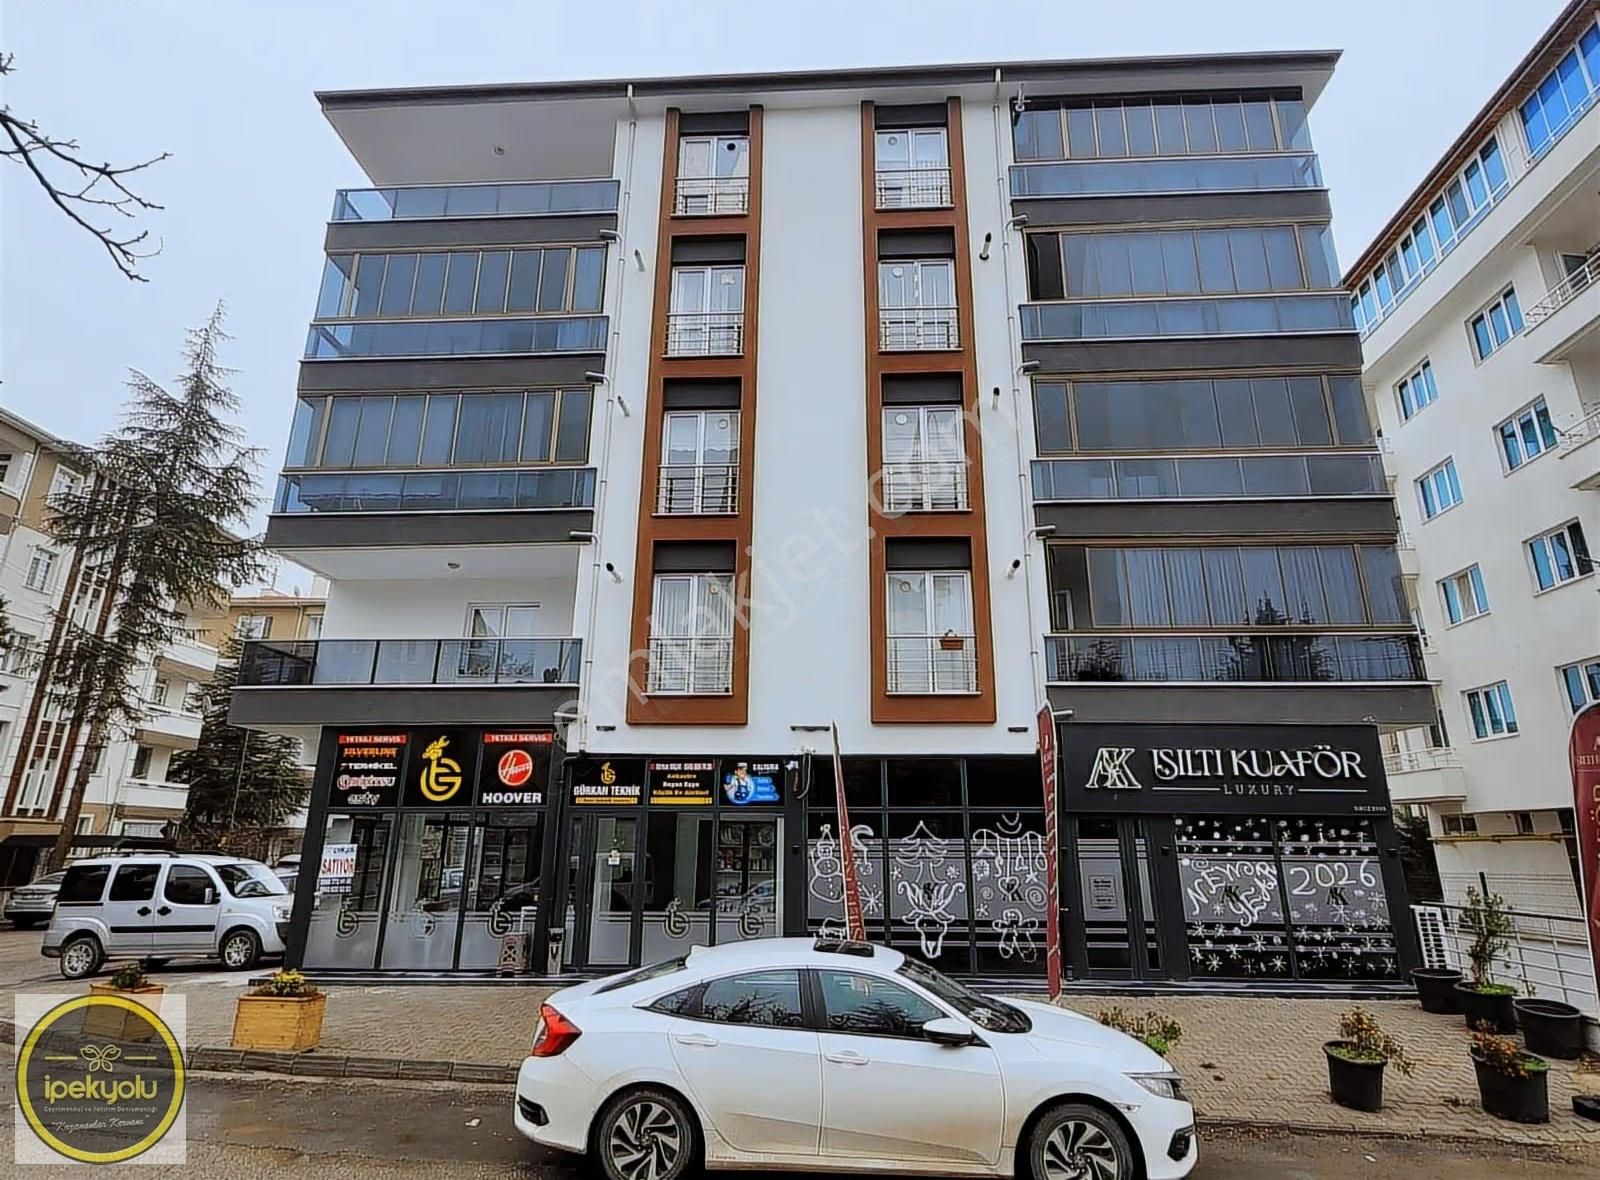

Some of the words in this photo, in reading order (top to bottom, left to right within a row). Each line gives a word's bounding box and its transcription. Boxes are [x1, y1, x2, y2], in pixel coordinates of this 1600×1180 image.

[1231, 744, 1367, 779] KUAFÖR
[611, 784, 641, 796] TEKNİK
[1223, 784, 1295, 796] LUXURY
[482, 792, 542, 804] HOOVER
[1290, 858, 1376, 896] 2026
